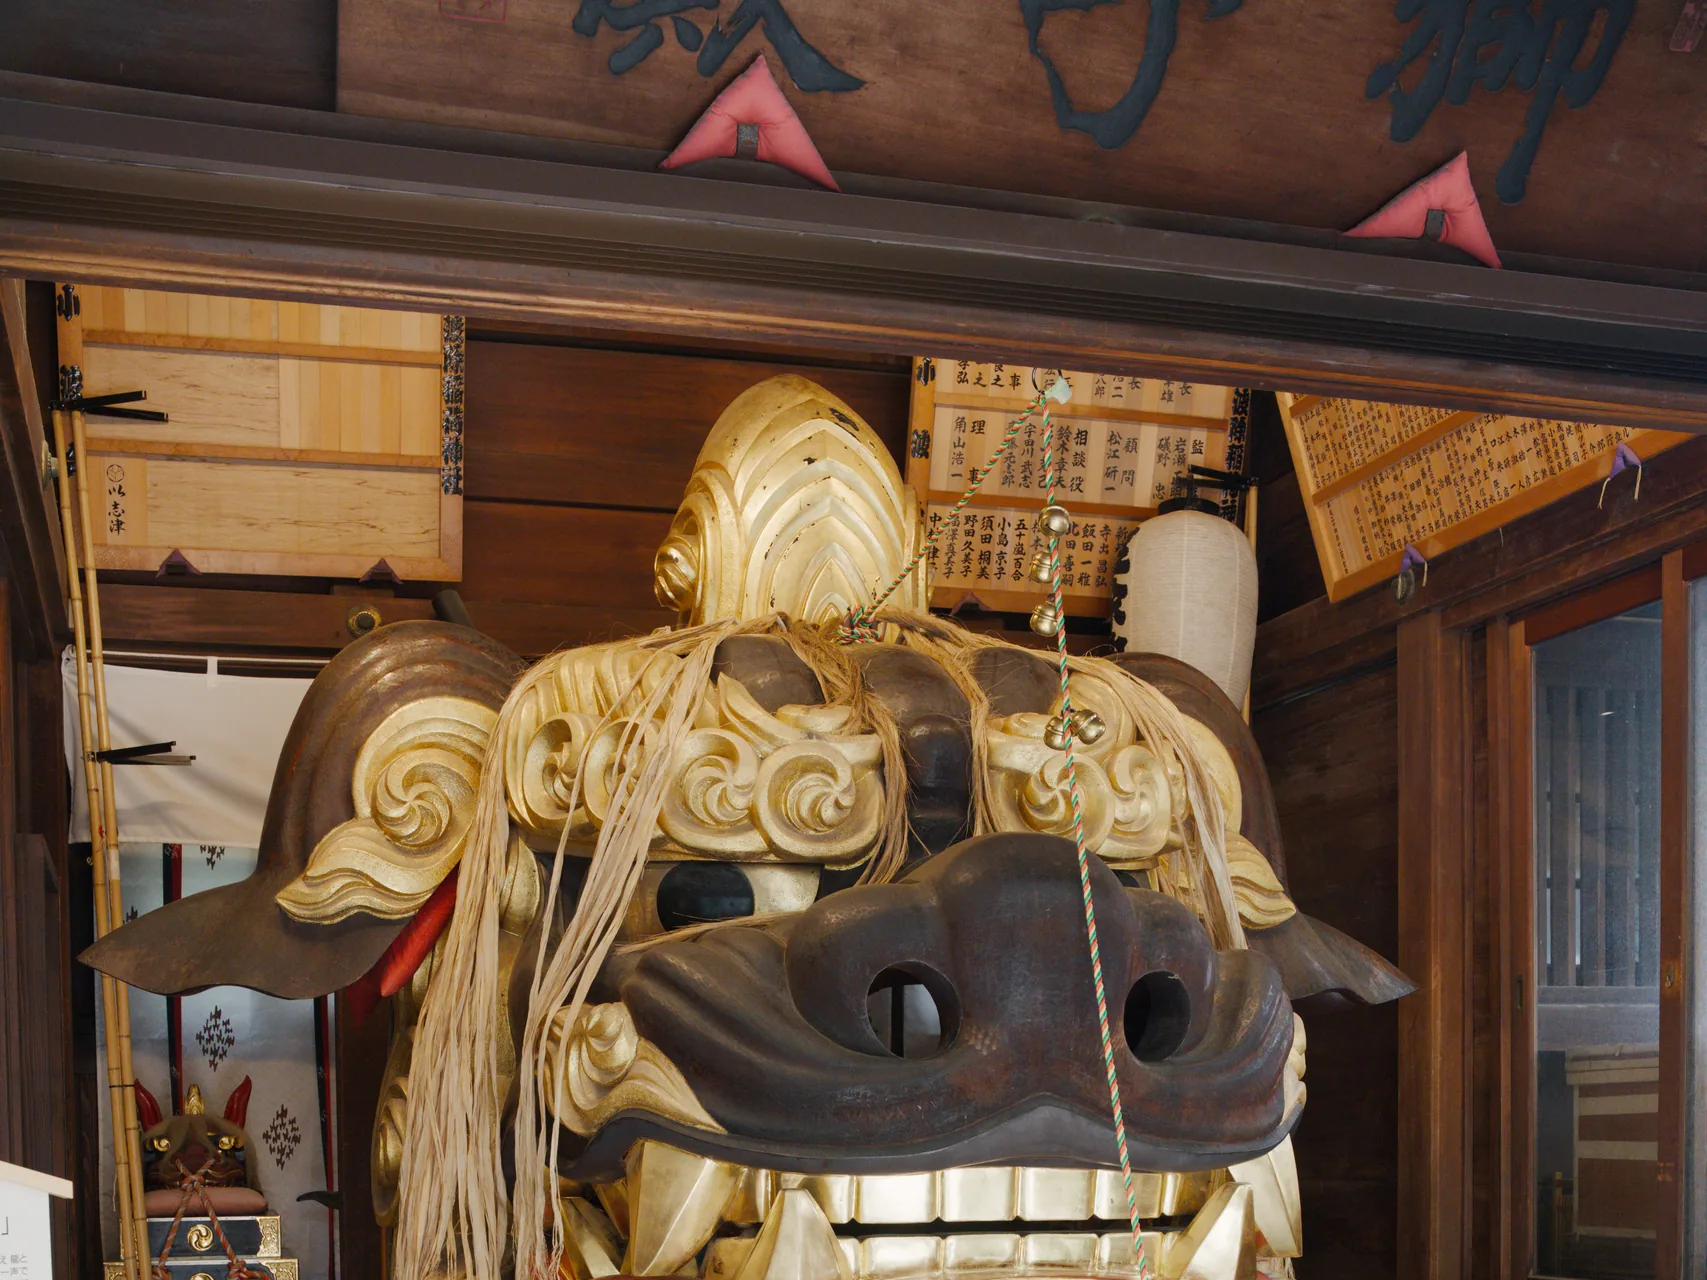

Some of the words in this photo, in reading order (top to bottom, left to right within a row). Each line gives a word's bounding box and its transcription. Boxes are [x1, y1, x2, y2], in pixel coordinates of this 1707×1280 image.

[1068, 428, 1088, 493] 相談役
[1120, 437, 1139, 488] 顧問
